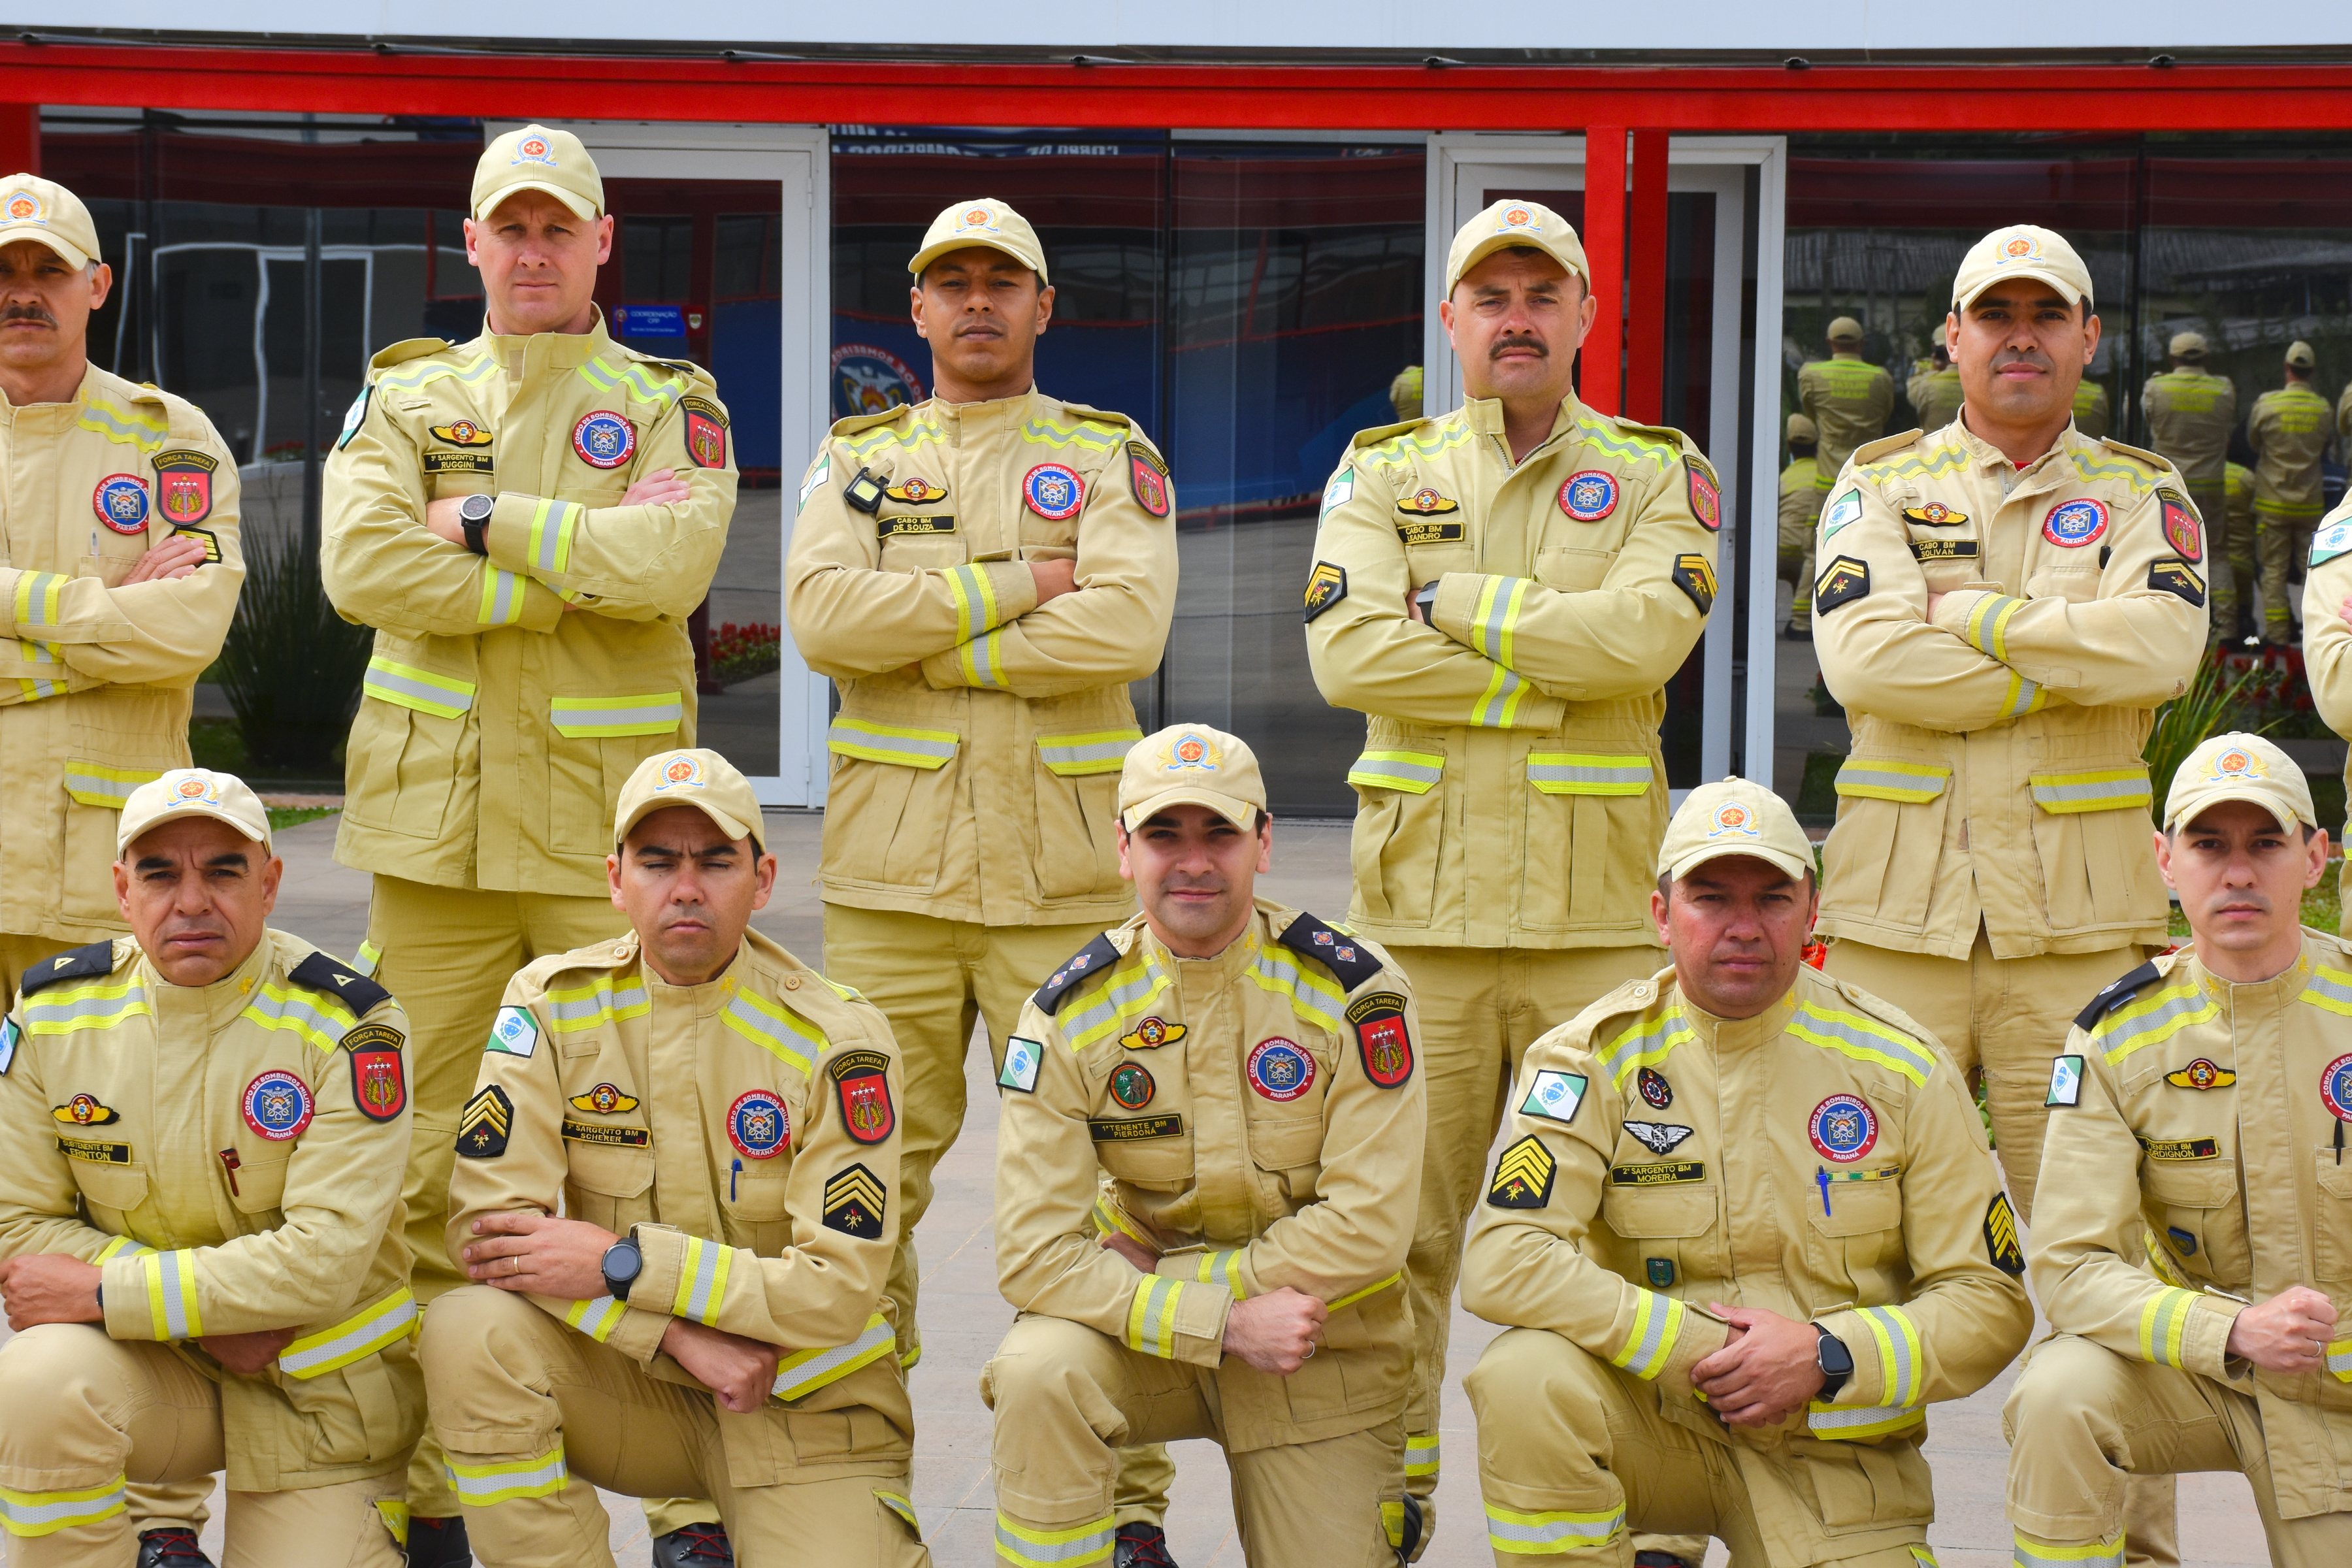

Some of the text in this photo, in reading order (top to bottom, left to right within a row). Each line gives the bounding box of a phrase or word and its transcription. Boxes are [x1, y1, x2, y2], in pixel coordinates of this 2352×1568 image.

[575, 424, 583, 444] CORPO
[591, 413, 627, 426] BOMBEIROS
[159, 455, 209, 466] FORÇA TAREFA
[1039, 466, 1074, 479] BOMBEIROS
[1580, 472, 1611, 483] BOMBEIROS
[2095, 506, 2104, 527] MILITAR
[1405, 526, 1424, 534] CABO
[1407, 532, 1440, 542] LEANDRO
[1919, 542, 1938, 550] CABO
[1921, 549, 1953, 557] SOLIVAN
[1352, 1001, 1375, 1017] FORÇA
[348, 1030, 397, 1045] FORÇA TAREFA
[1256, 1046, 1265, 1055] DE
[1264, 1039, 1303, 1054] BOMBEIROS
[1302, 1053, 1313, 1076] MILITAR
[836, 1056, 881, 1073] FORÇA TAREFA
[2323, 1071, 2332, 1095] CORPO
[251, 1081, 260, 1089] DE
[260, 1073, 300, 1086] BOMBEIROS
[299, 1086, 310, 1113] MILITAR
[743, 1094, 779, 1107] BOMBEIROS
[779, 1107, 789, 1134] MILITAR
[1817, 1105, 1825, 1113] DE
[1825, 1096, 1865, 1109] BOMBEIROS
[1863, 1108, 1874, 1135] MILITAR
[266, 1130, 293, 1138] PARANÁ
[576, 1126, 621, 1135] SARGENTO
[1114, 1127, 1156, 1137] PIERDONÁ
[581, 1133, 621, 1143] SCHERER
[63, 1140, 101, 1150] SUBTENENTE
[70, 1148, 110, 1161] ERINTON
[1833, 1151, 1860, 1160] PARANÁ
[1631, 1166, 1675, 1174] SARGENTO
[1637, 1173, 1677, 1183] MOREIRA
